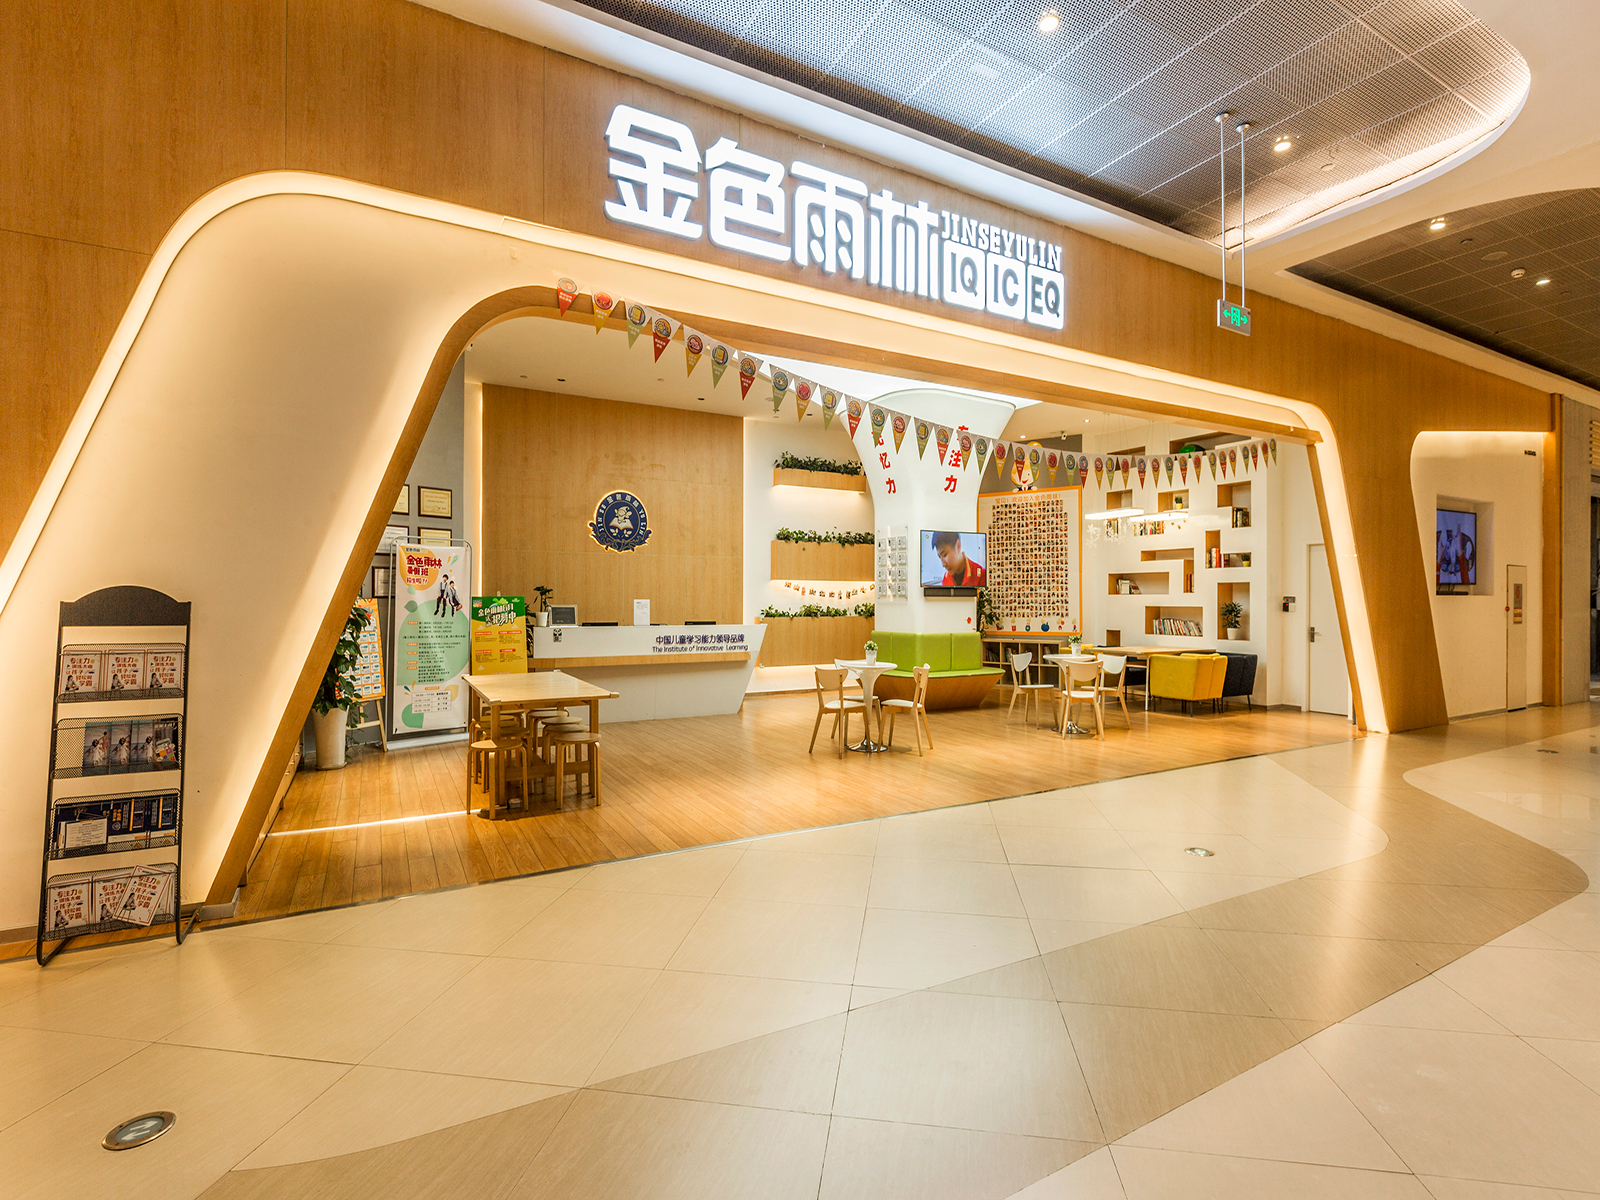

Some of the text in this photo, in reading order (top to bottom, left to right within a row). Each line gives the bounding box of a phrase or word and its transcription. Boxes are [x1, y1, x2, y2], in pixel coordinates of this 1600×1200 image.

[604, 104, 939, 300] 金色雨林
[941, 210, 1062, 272] JINSEYULIN
[951, 252, 1060, 318] IQ IC EQ
[944, 425, 969, 493] 注力
[406, 554, 443, 569] 金色雨林
[656, 634, 745, 644] 中国儿童学习能力领导品牌
